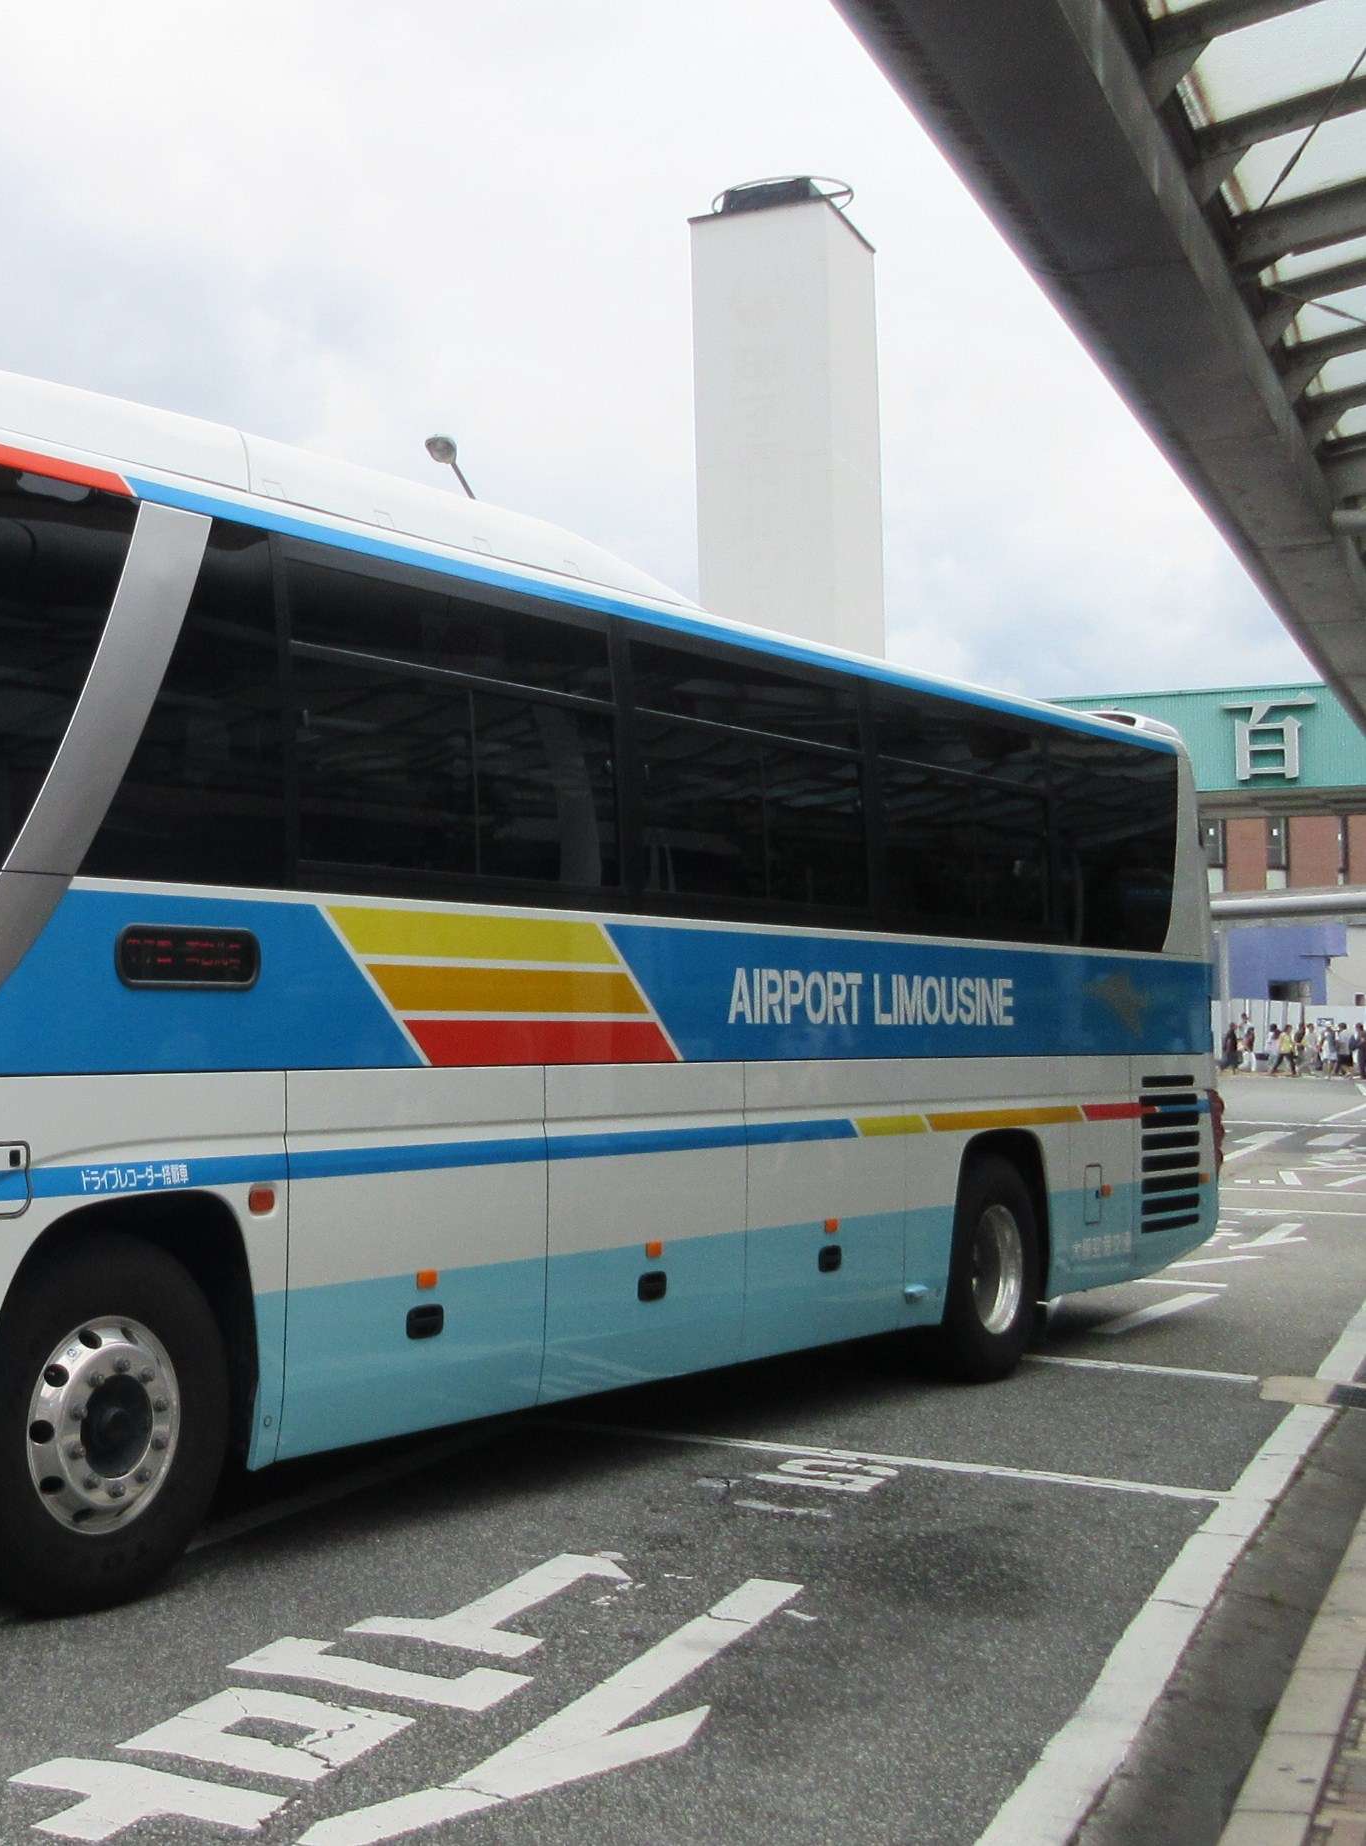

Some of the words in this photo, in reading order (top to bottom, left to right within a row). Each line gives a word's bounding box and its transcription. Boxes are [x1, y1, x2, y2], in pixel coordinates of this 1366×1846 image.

[1220, 692, 1317, 781] 百
[727, 967, 862, 1025] AIRPORT
[873, 973, 1014, 1026] LIMOUSINE
